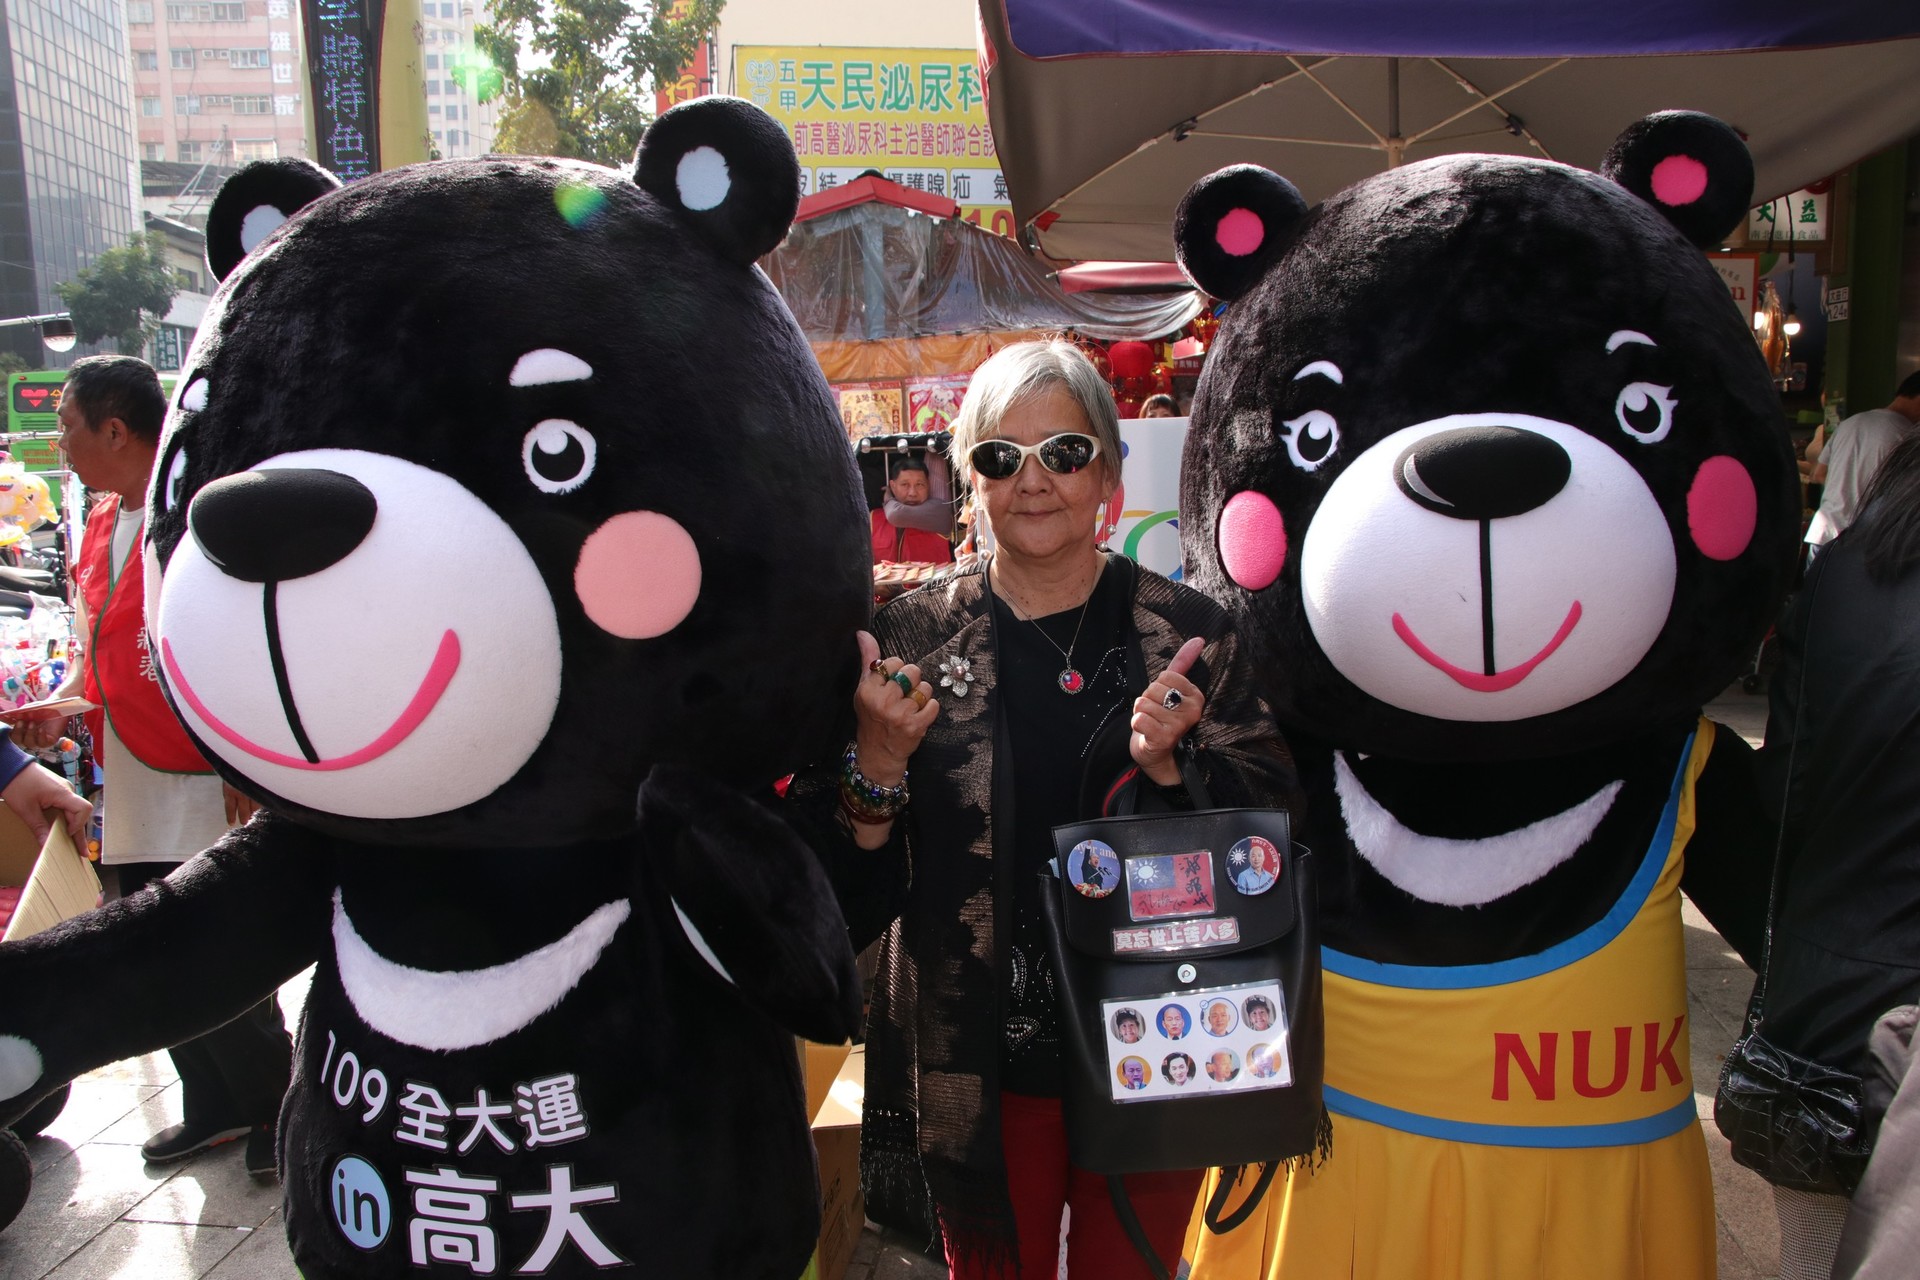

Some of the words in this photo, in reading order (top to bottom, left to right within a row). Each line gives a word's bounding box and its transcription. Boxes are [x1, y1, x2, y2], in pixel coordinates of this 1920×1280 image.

[779, 60, 797, 112] 五甲
[801, 61, 984, 112] 天民泌尿科
[1115, 921, 1236, 950] 莫忘世上苦人多
[320, 1029, 388, 1123] 109
[396, 1073, 587, 1153] 全大運
[1491, 1014, 1685, 1101] NUK
[406, 1166, 625, 1274] 高大
